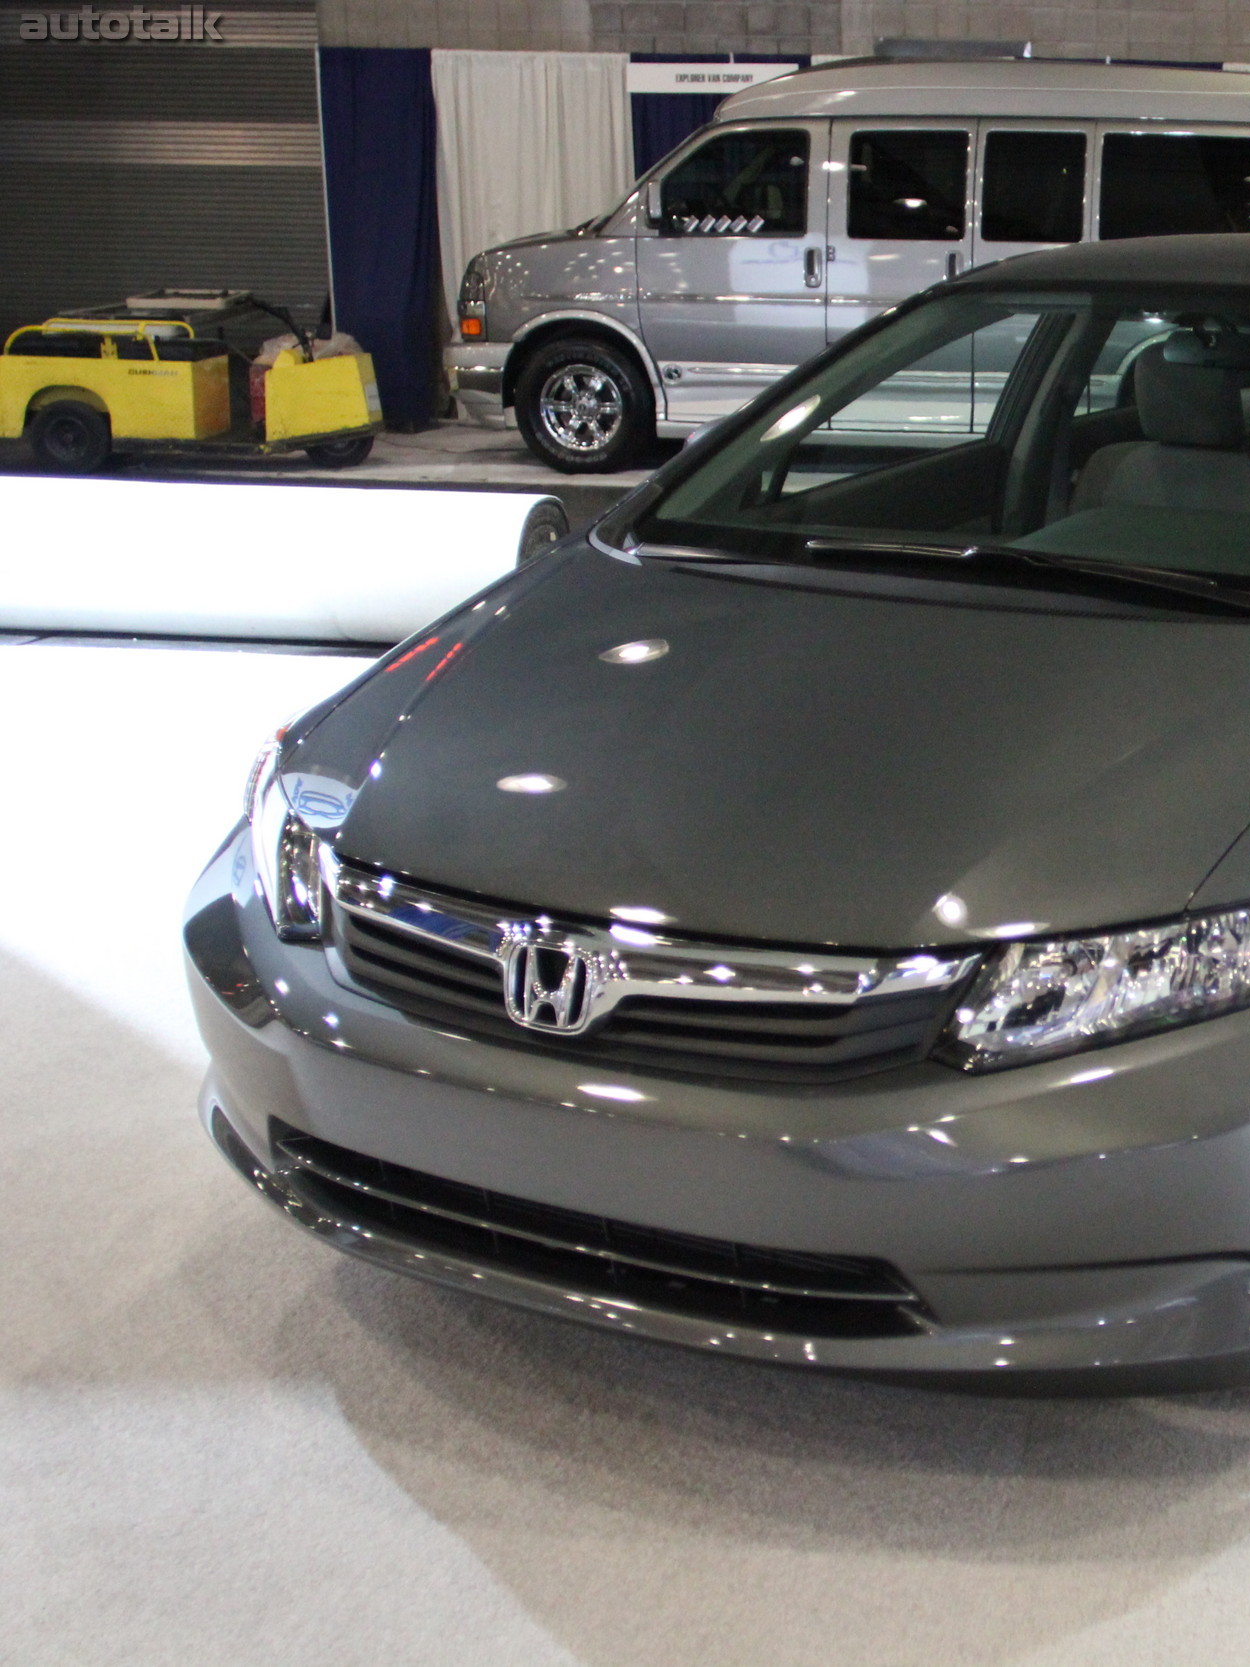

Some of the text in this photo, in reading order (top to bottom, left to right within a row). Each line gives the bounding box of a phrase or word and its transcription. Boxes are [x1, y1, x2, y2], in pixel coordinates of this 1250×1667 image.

[675, 74, 753, 82] EXPLORER VAN COMPANY
